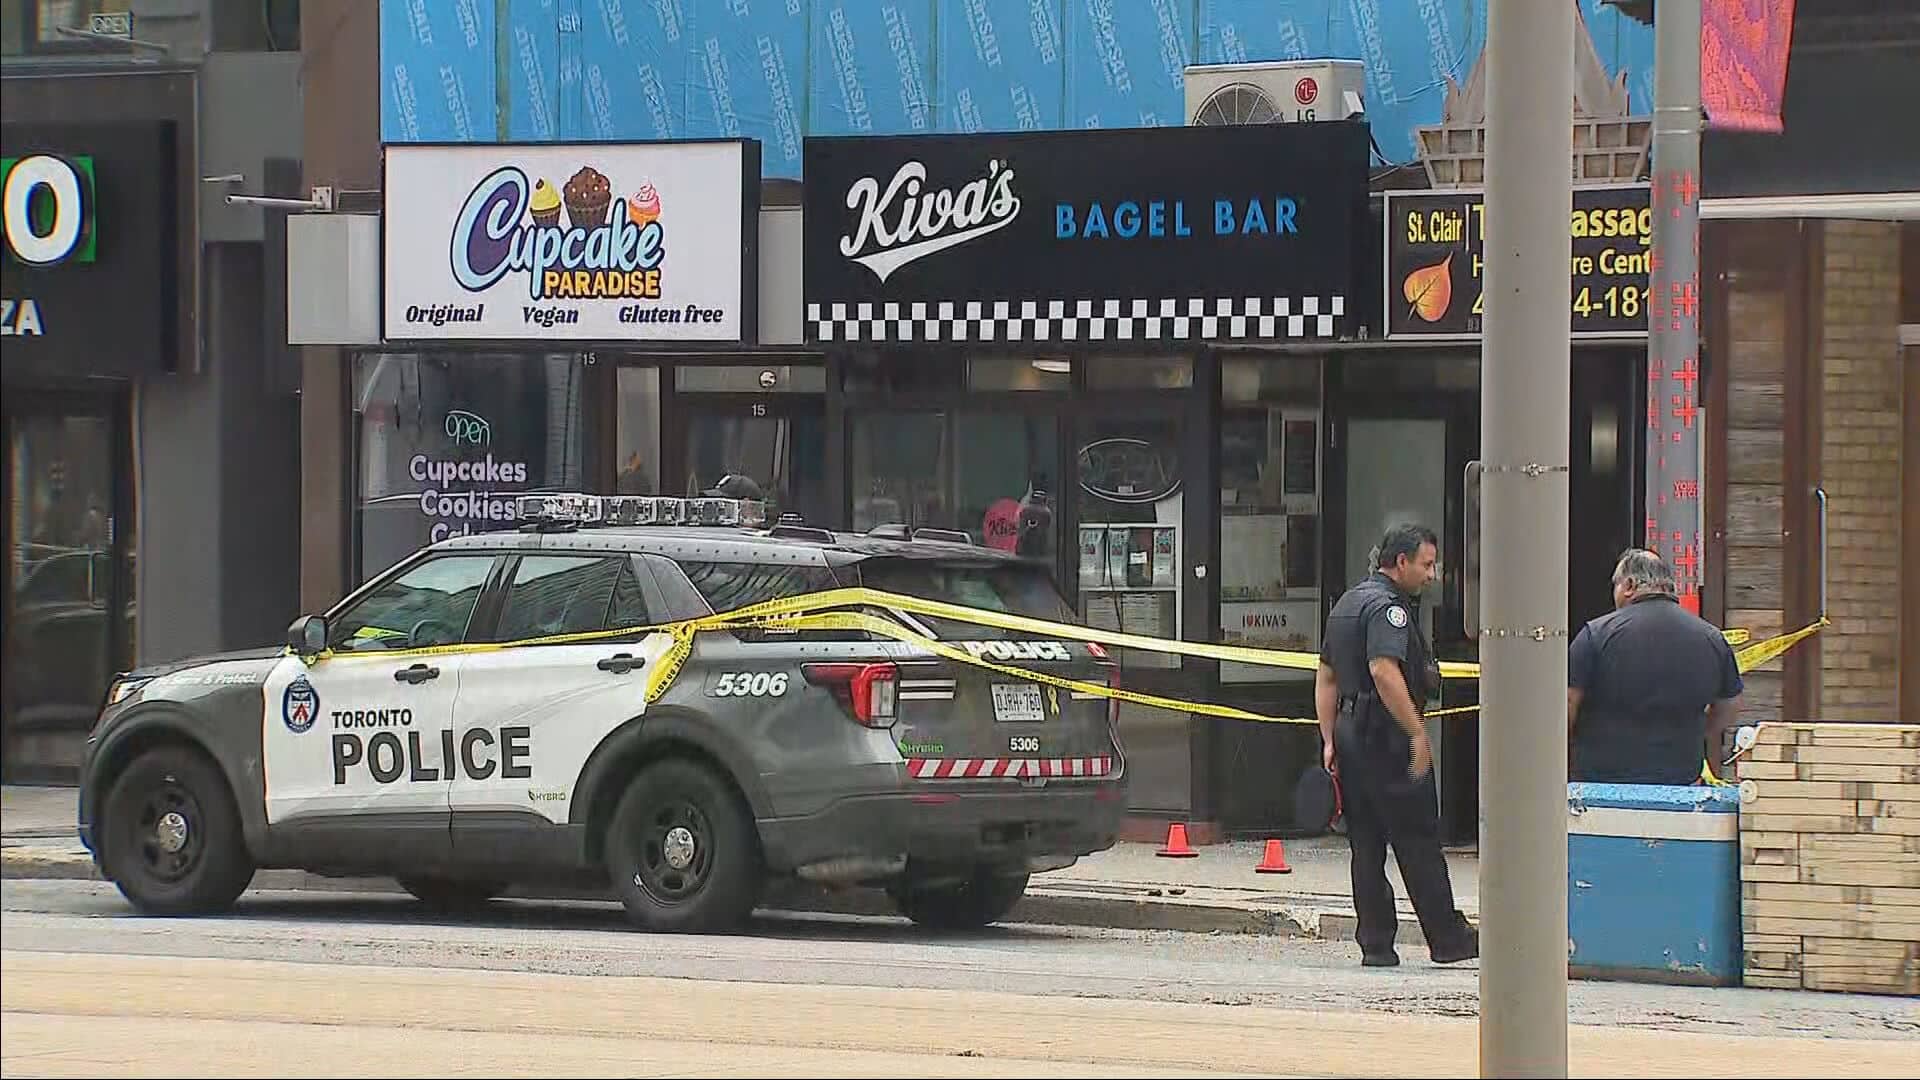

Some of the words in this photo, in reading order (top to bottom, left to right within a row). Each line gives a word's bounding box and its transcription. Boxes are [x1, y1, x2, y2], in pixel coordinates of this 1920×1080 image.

[92, 16, 129, 34] OPEN
[1297, 110, 1316, 122] LG
[840, 159, 1020, 257] Kiva's
[1056, 202, 1191, 239] BAGEL
[1215, 200, 1298, 235] BAR
[451, 166, 665, 300] Cupcake
[1407, 212, 1426, 242] St.
[1430, 210, 1463, 242] Clair
[1571, 208, 1651, 244] assag
[543, 270, 661, 298] PARADISE
[0, 299, 43, 336] ZA
[405, 303, 484, 326] Original
[522, 305, 579, 328] Vegan
[618, 305, 680, 324] Gluten
[684, 303, 724, 323] free
[583, 353, 596, 366] 15
[752, 404, 766, 417] 15
[409, 453, 527, 489] Cupcakes
[421, 489, 516, 520] Cookies
[1254, 614, 1287, 628] KIVA'S
[961, 640, 1071, 661] POLICE
[715, 672, 788, 697] 5306
[332, 709, 412, 728] TORONTO
[332, 727, 532, 784] POLICE
[1009, 735, 1040, 752] 5306
